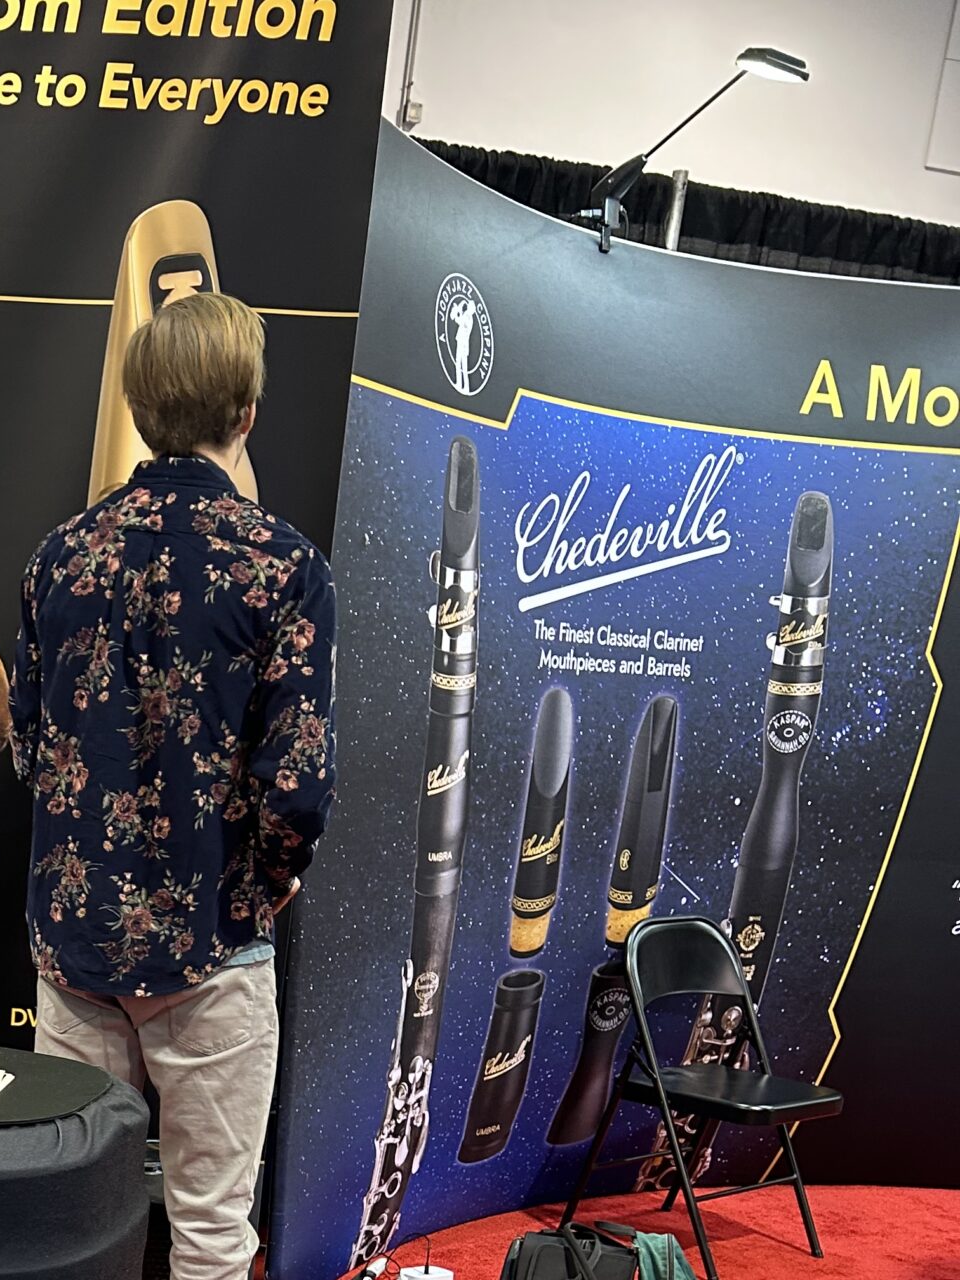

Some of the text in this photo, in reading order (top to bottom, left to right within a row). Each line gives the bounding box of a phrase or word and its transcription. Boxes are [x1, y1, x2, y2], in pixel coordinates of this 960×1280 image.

[35, 66, 86, 106] to
[99, 63, 329, 124] Everyone
[476, 303, 492, 380] COMPANY
[799, 359, 844, 419] A
[515, 446, 737, 590] Chedeville
[534, 619, 704, 653] The Finest Classical Clarinet
[540, 649, 691, 678] Mouthpieces and Barrels
[773, 714, 806, 729] KASPAR
[428, 851, 452, 862] UMBRA
